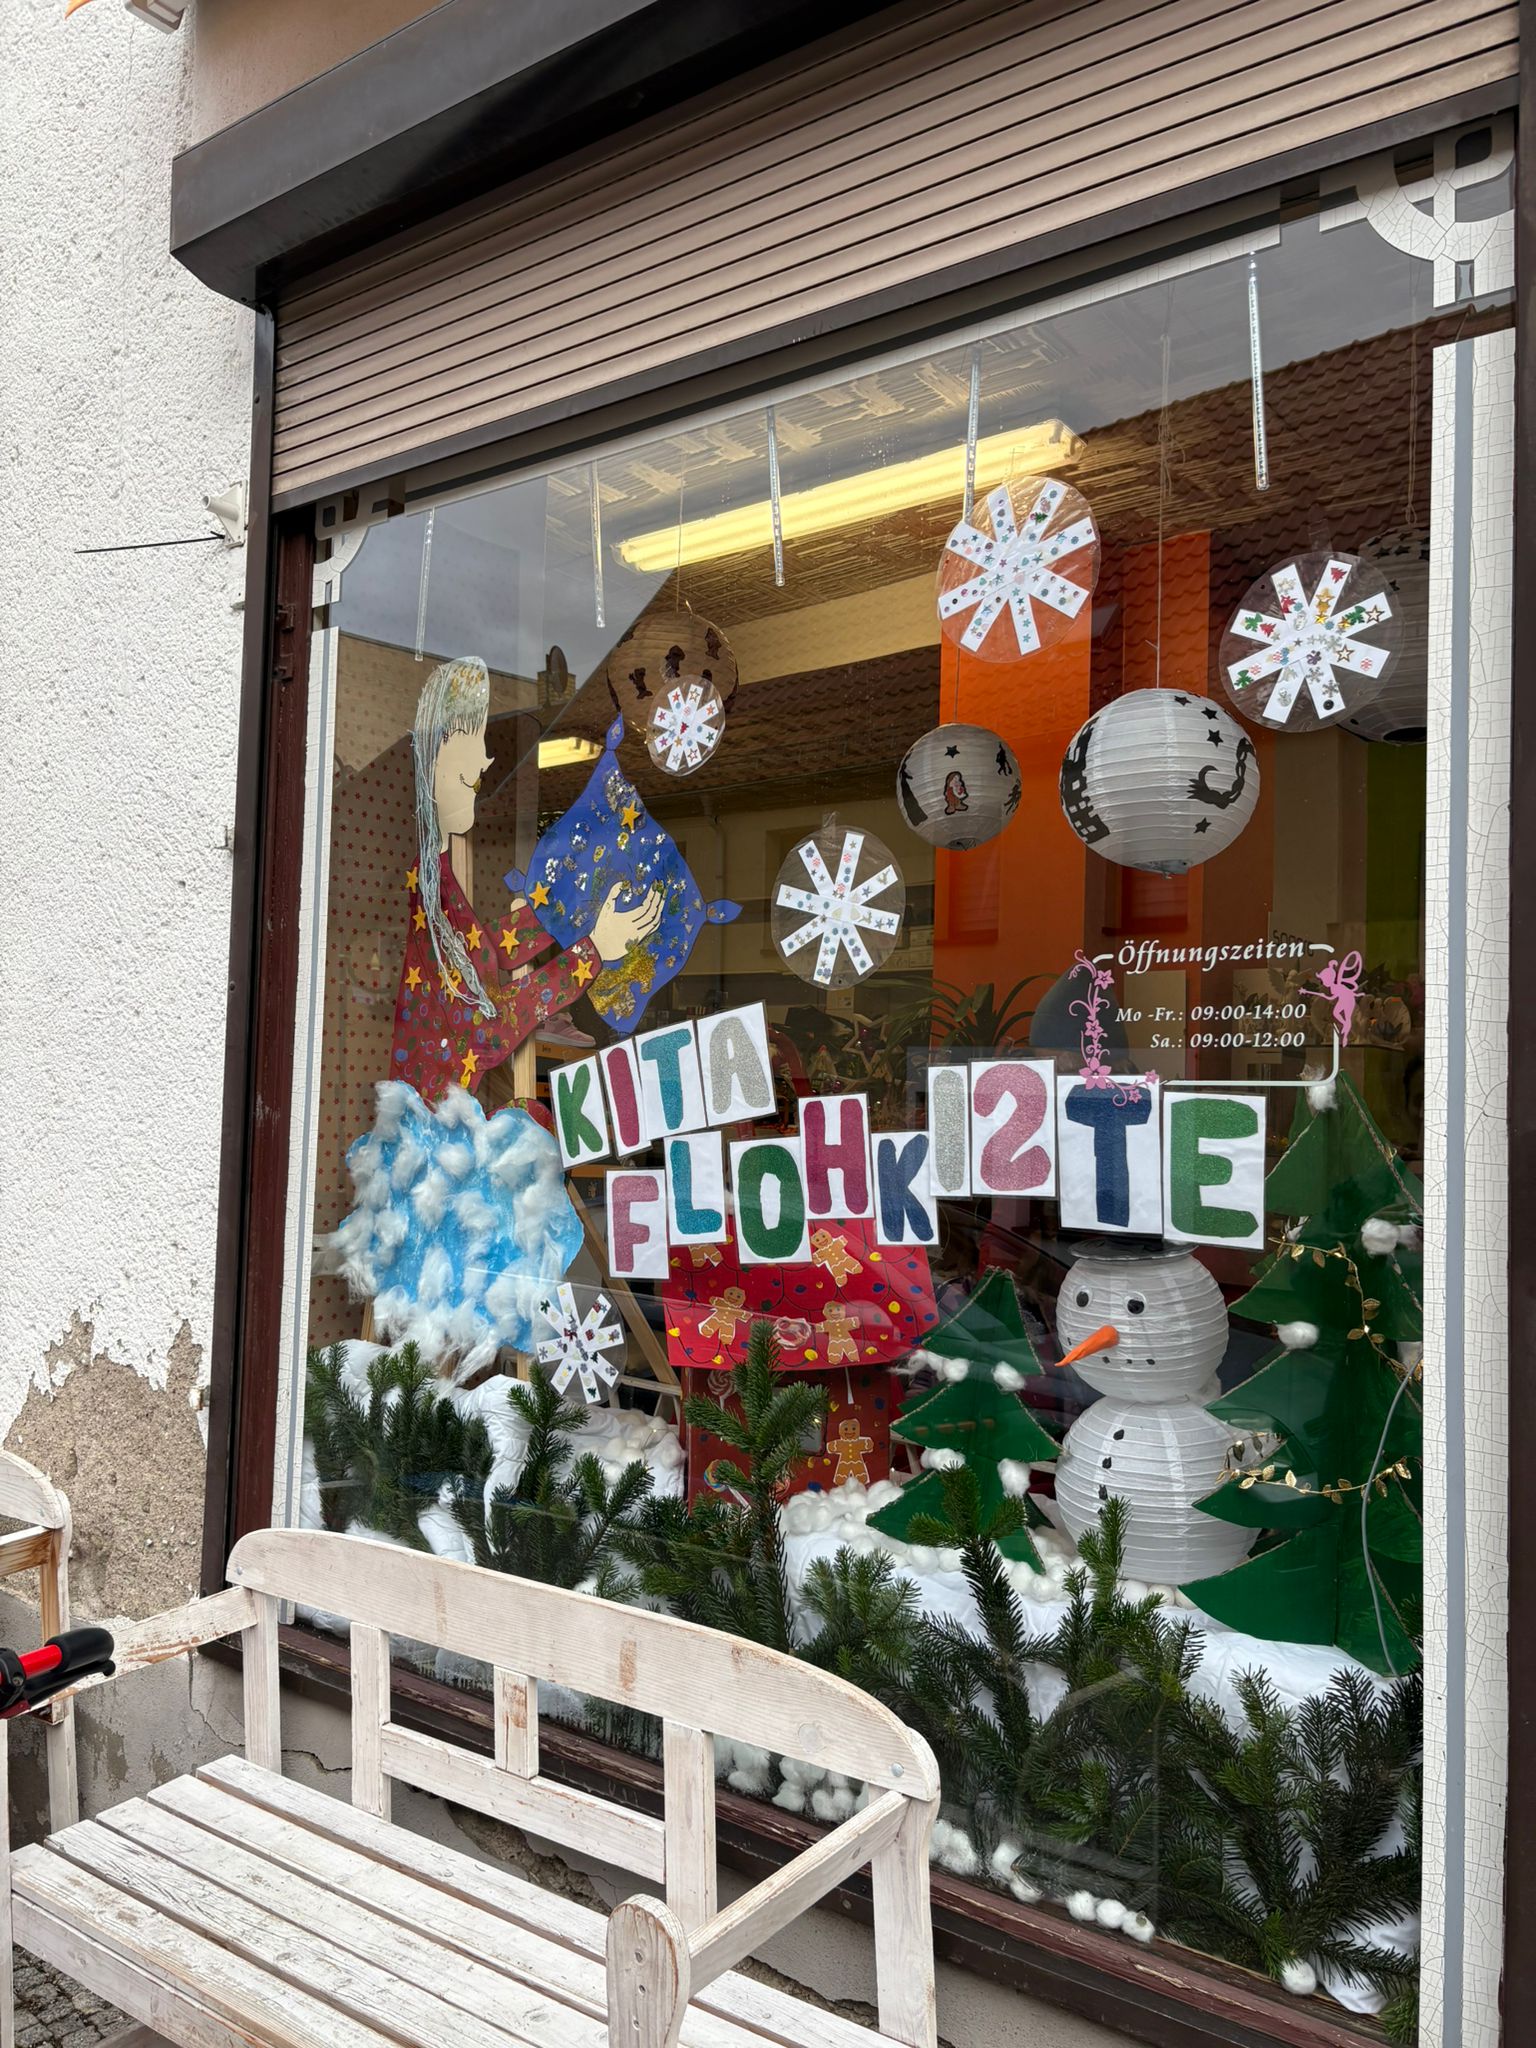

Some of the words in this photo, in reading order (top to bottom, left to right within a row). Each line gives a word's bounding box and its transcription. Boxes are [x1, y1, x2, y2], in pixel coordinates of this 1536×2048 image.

[1117, 938, 1305, 975] Öffnungszeiten
[1115, 1006, 1142, 1022] Mo
[1190, 1003, 1307, 1021] 09:00-14:00
[1150, 1033, 1183, 1048] Sa.:
[1189, 1031, 1306, 1048] 09:00-12:00
[557, 1016, 772, 1158] KITA
